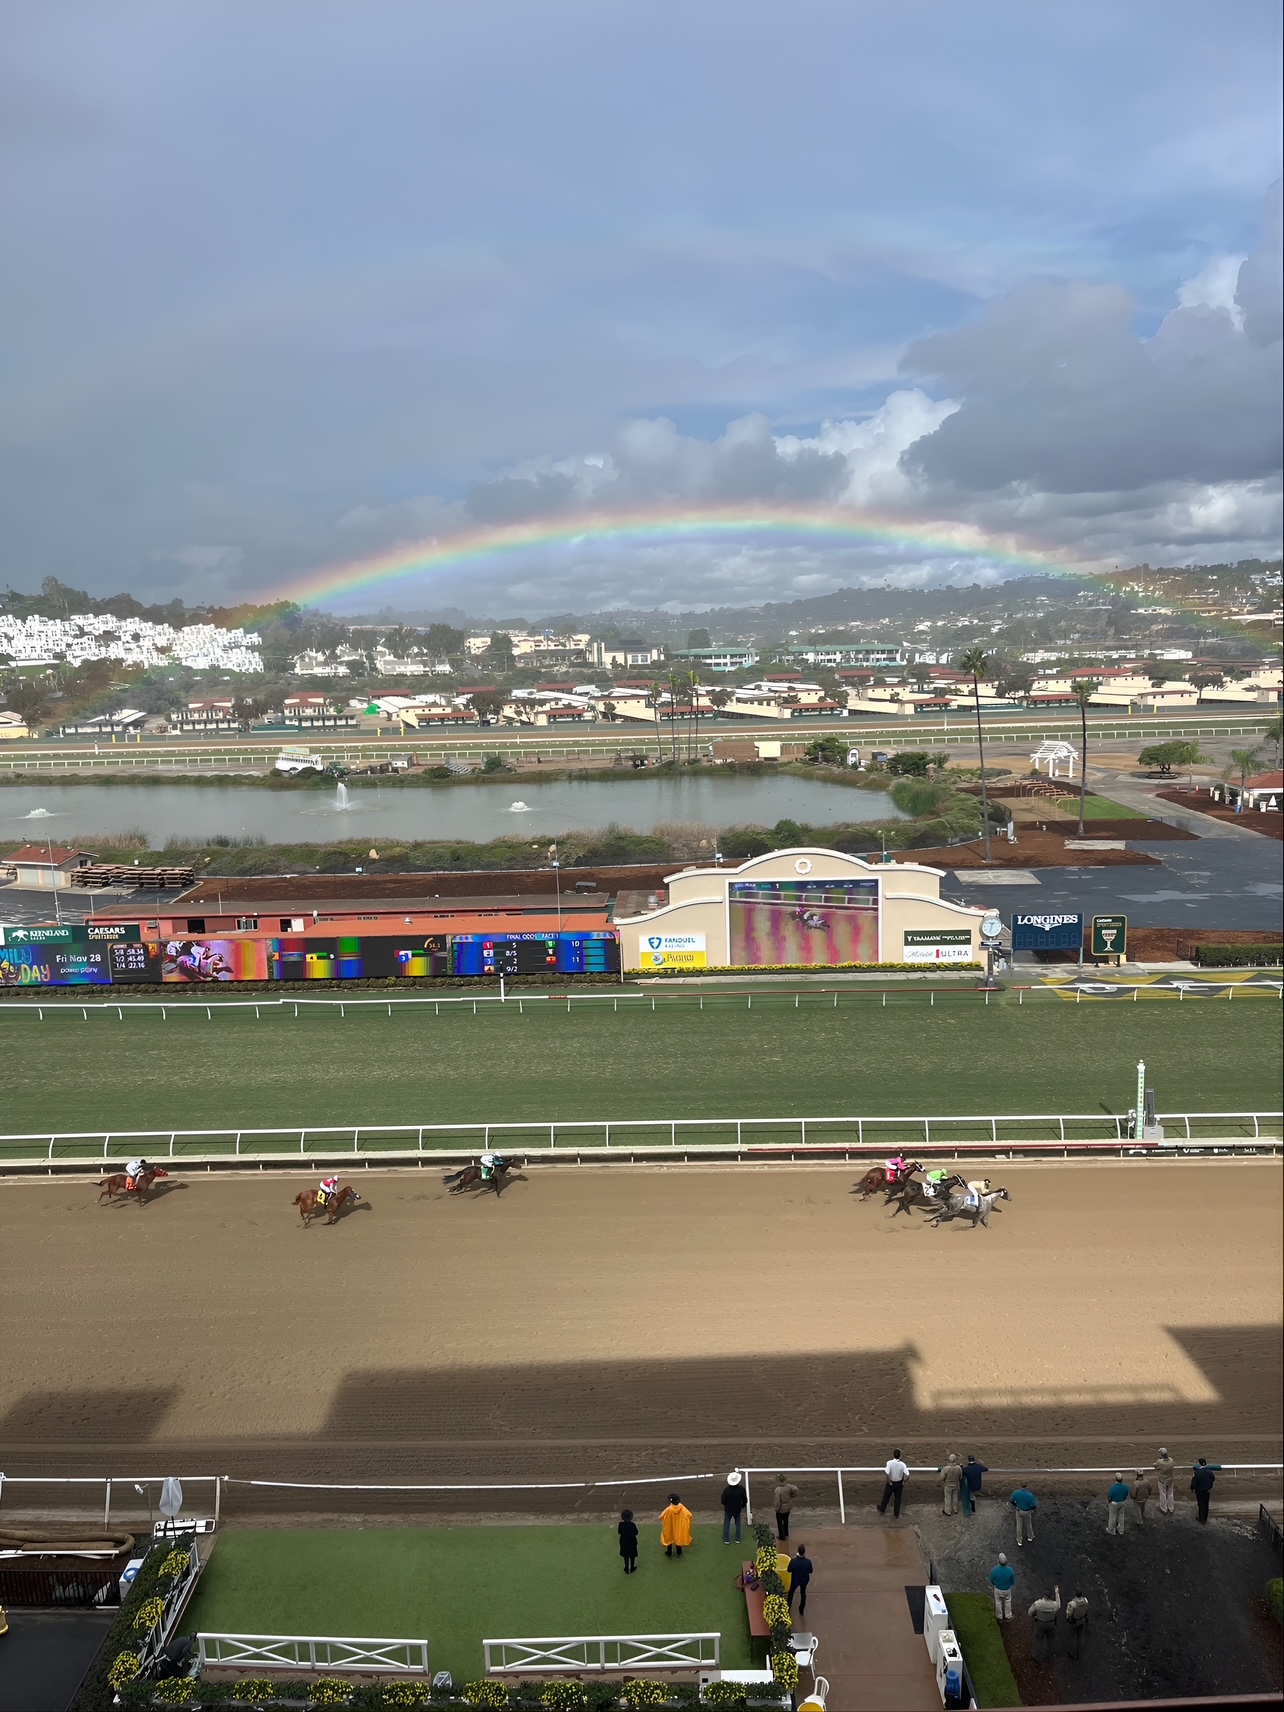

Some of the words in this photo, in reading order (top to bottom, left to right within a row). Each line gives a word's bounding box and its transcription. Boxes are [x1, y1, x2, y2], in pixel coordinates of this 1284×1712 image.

[1017, 914, 1078, 925] LONGINES
[88, 927, 125, 935] CAESARS
[56, 954, 67, 963] Fri
[69, 954, 87, 962] Nov
[89, 953, 101, 962] 28
[21, 963, 51, 983] DAY
